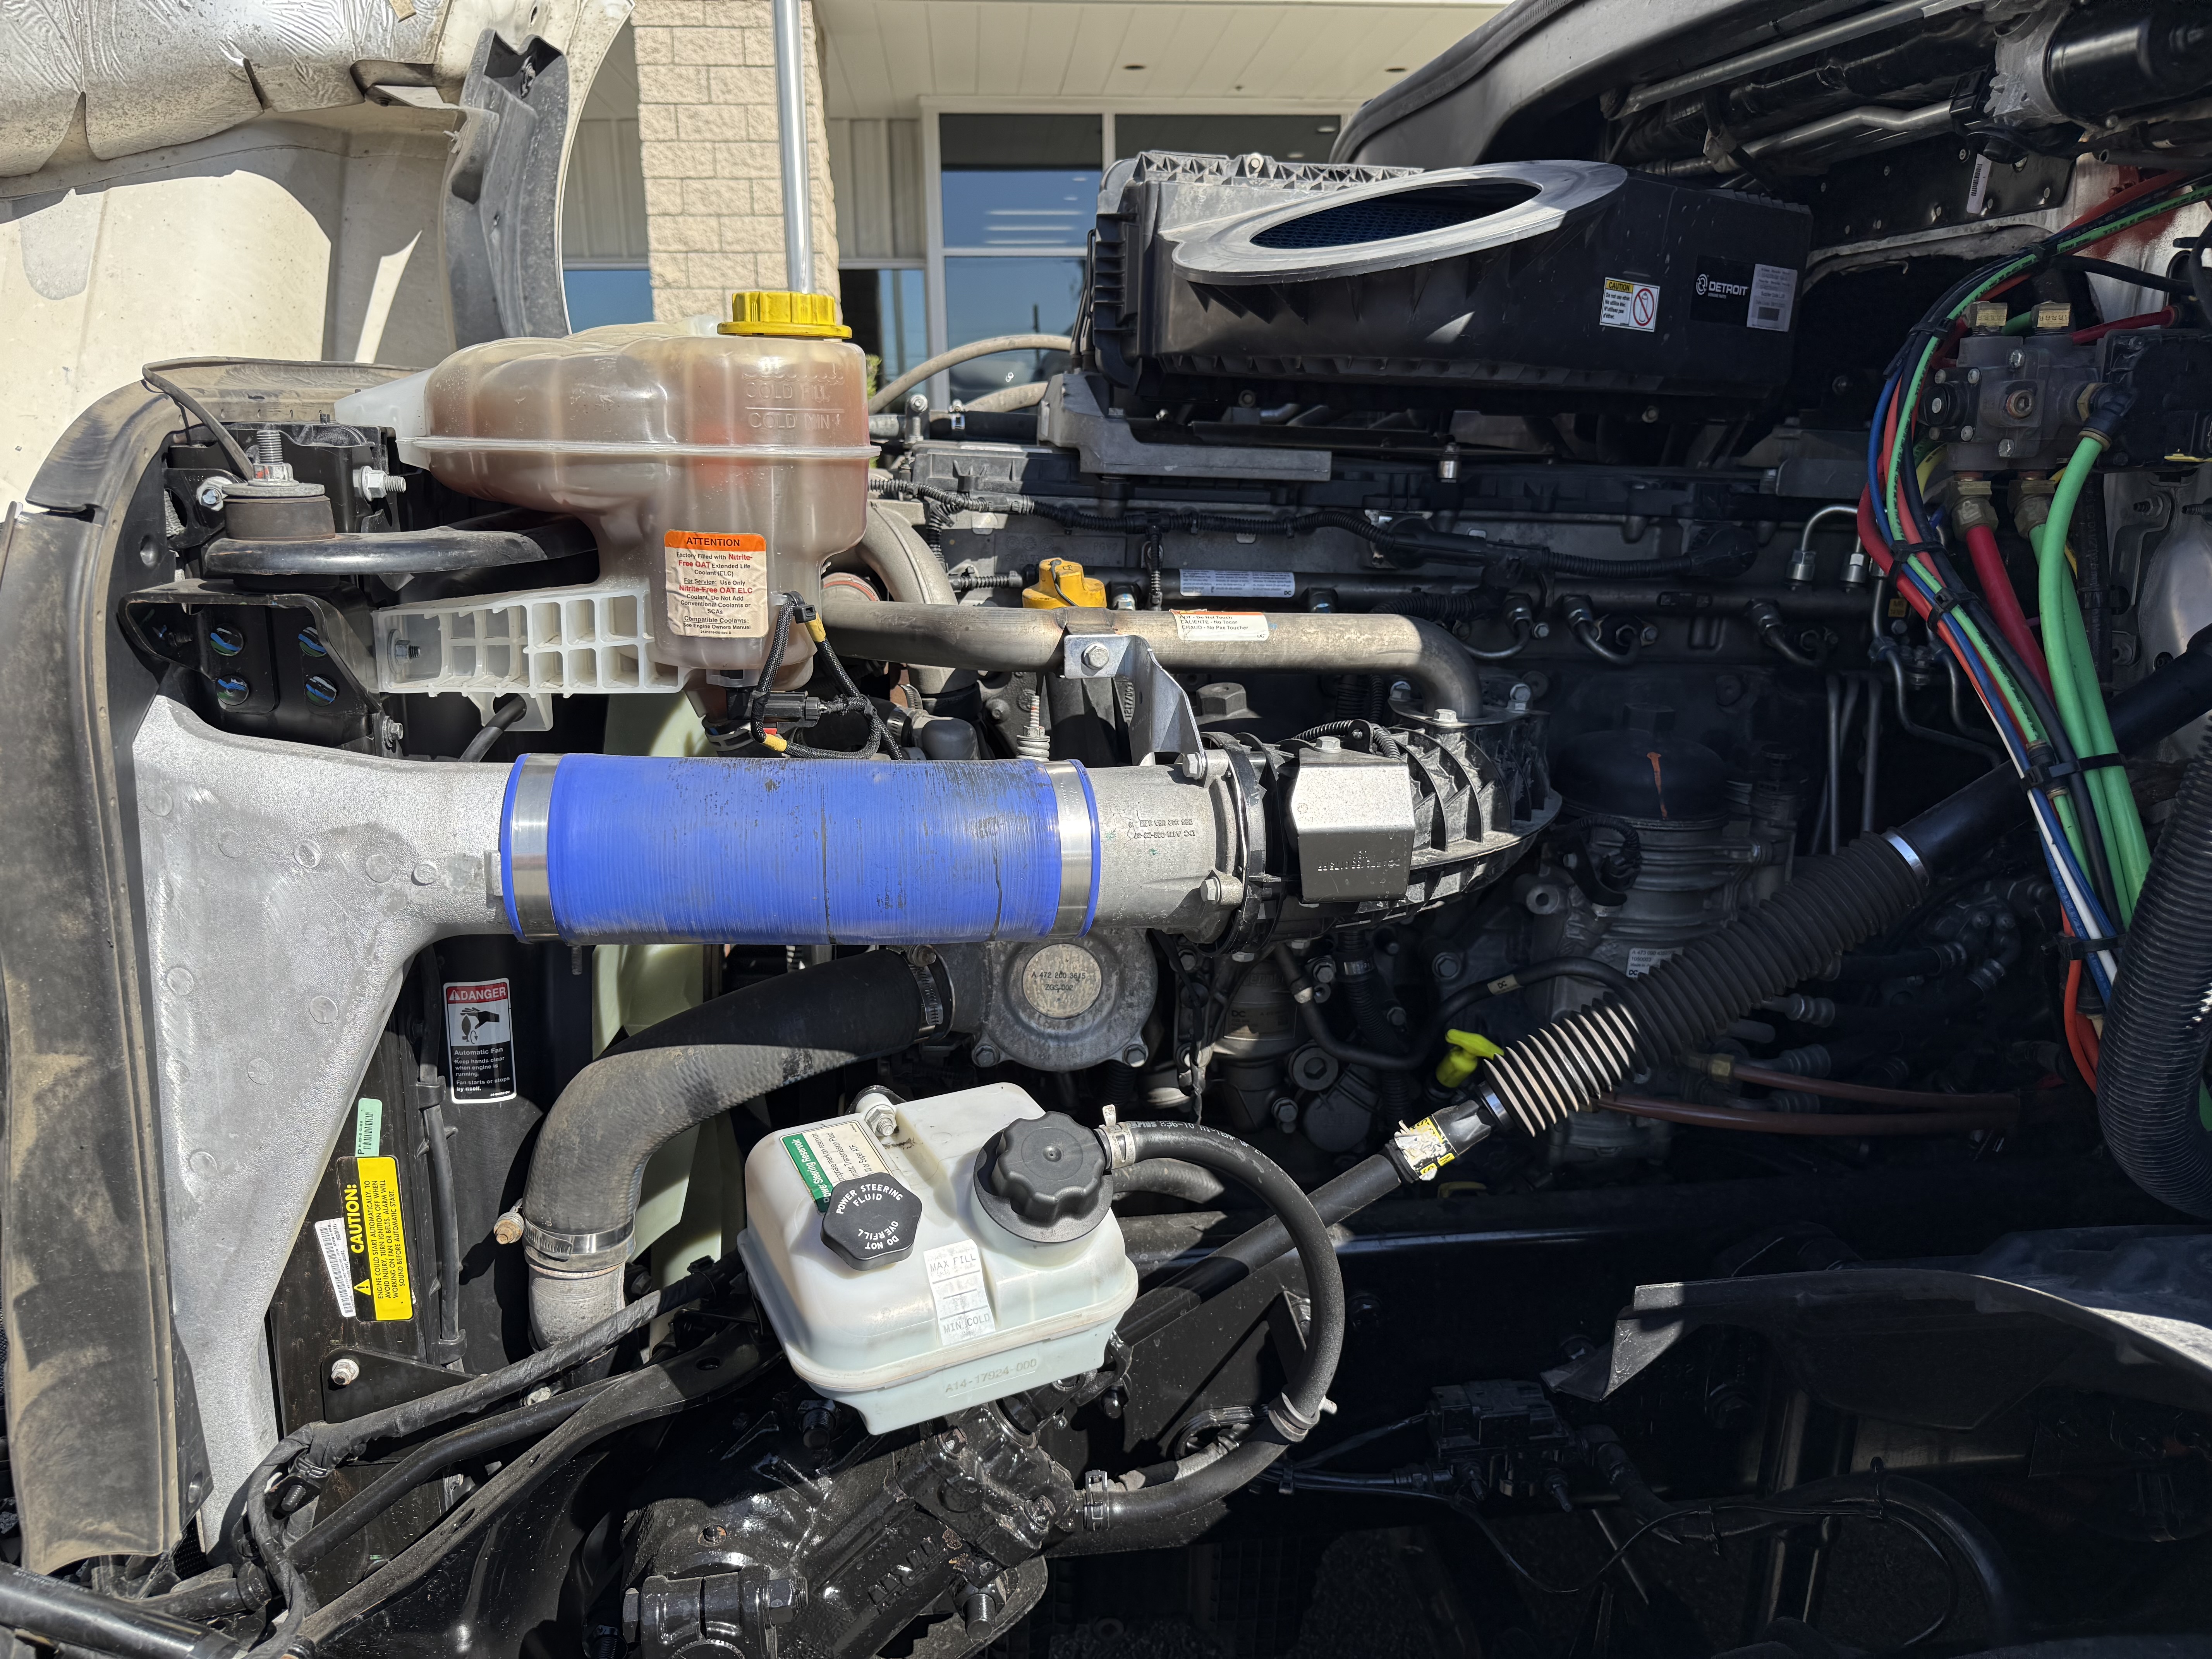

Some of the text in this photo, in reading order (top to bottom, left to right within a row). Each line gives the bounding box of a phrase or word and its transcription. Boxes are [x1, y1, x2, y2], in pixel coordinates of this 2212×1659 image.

[1609, 282, 1630, 291] CAUTION
[1709, 281, 1748, 296] DETROIT
[746, 382, 793, 400] COLD
[748, 413, 796, 429] COLD
[686, 537, 740, 546] ATTENTION
[461, 986, 506, 1000] DANGER
[826, 1132, 836, 1142] Fluid
[792, 1139, 811, 1163] Reservoir
[806, 1162, 824, 1184] Steering
[836, 1184, 903, 1214] POWER STEERING
[853, 1193, 882, 1207] FLUID
[344, 1184, 364, 1253] CAUTION:
[365, 1190, 377, 1237] AUTOMATICALLY.
[375, 1213, 384, 1239] IGNITION
[391, 1209, 400, 1242] AUTOMATIC
[858, 1221, 899, 1240] OVERFILL
[865, 1235, 899, 1250] DO NOT
[389, 1259, 395, 1268] ON
[930, 1254, 976, 1273] MAX FILL
[376, 1278, 384, 1299] ENGINE
[390, 1270, 398, 1298] WORKING
[943, 1313, 990, 1334] MIN COLD
[945, 1358, 1037, 1392] A14-17924-000
